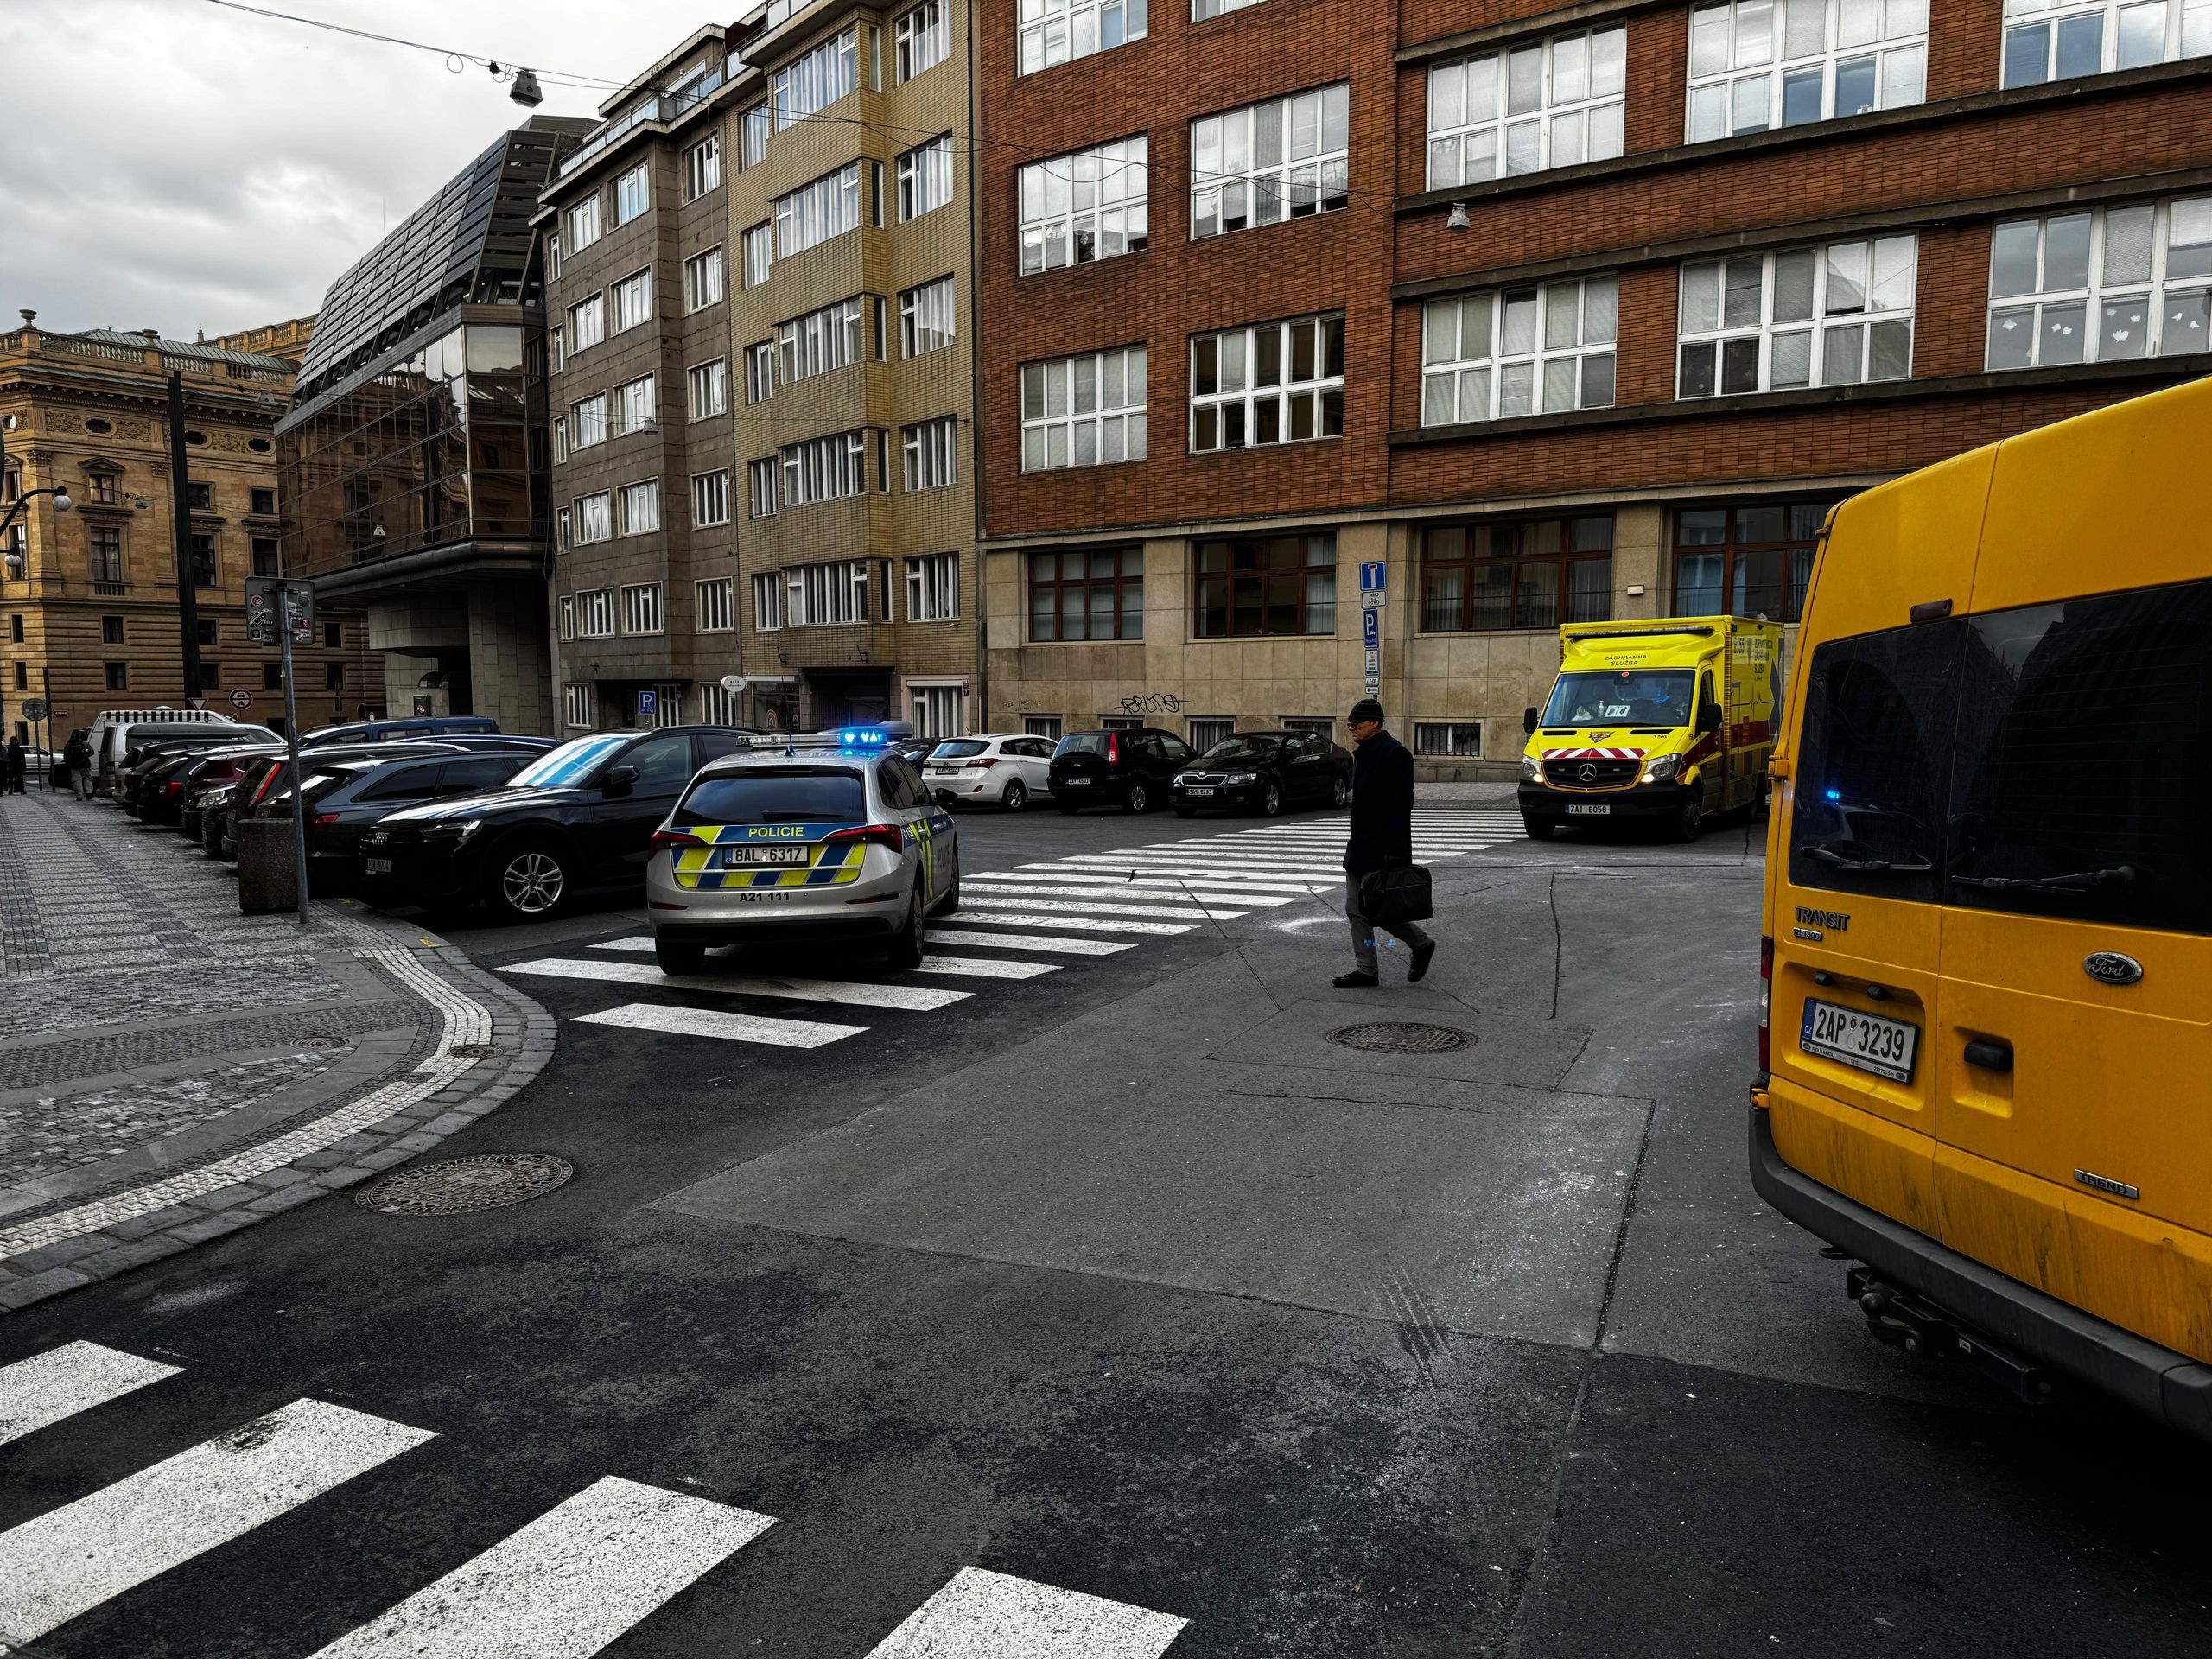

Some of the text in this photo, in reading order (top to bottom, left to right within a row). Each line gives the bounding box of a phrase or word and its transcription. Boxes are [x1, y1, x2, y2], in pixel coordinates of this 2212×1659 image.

[1366, 613, 1374, 635] P
[642, 694, 652, 708] P
[1588, 805, 1607, 814] 6058
[748, 826, 804, 838] POLICIE
[735, 847, 802, 862] 8AL 6317
[740, 891, 790, 902] A21 111
[1796, 906, 1851, 931] TRANSIT
[2089, 957, 2126, 977] Ford
[1804, 1025, 1813, 1035] CZ
[1815, 1008, 1847, 1044] 2AP
[1858, 1020, 1905, 1062] 3239
[2079, 1172, 2127, 1194] TREND
